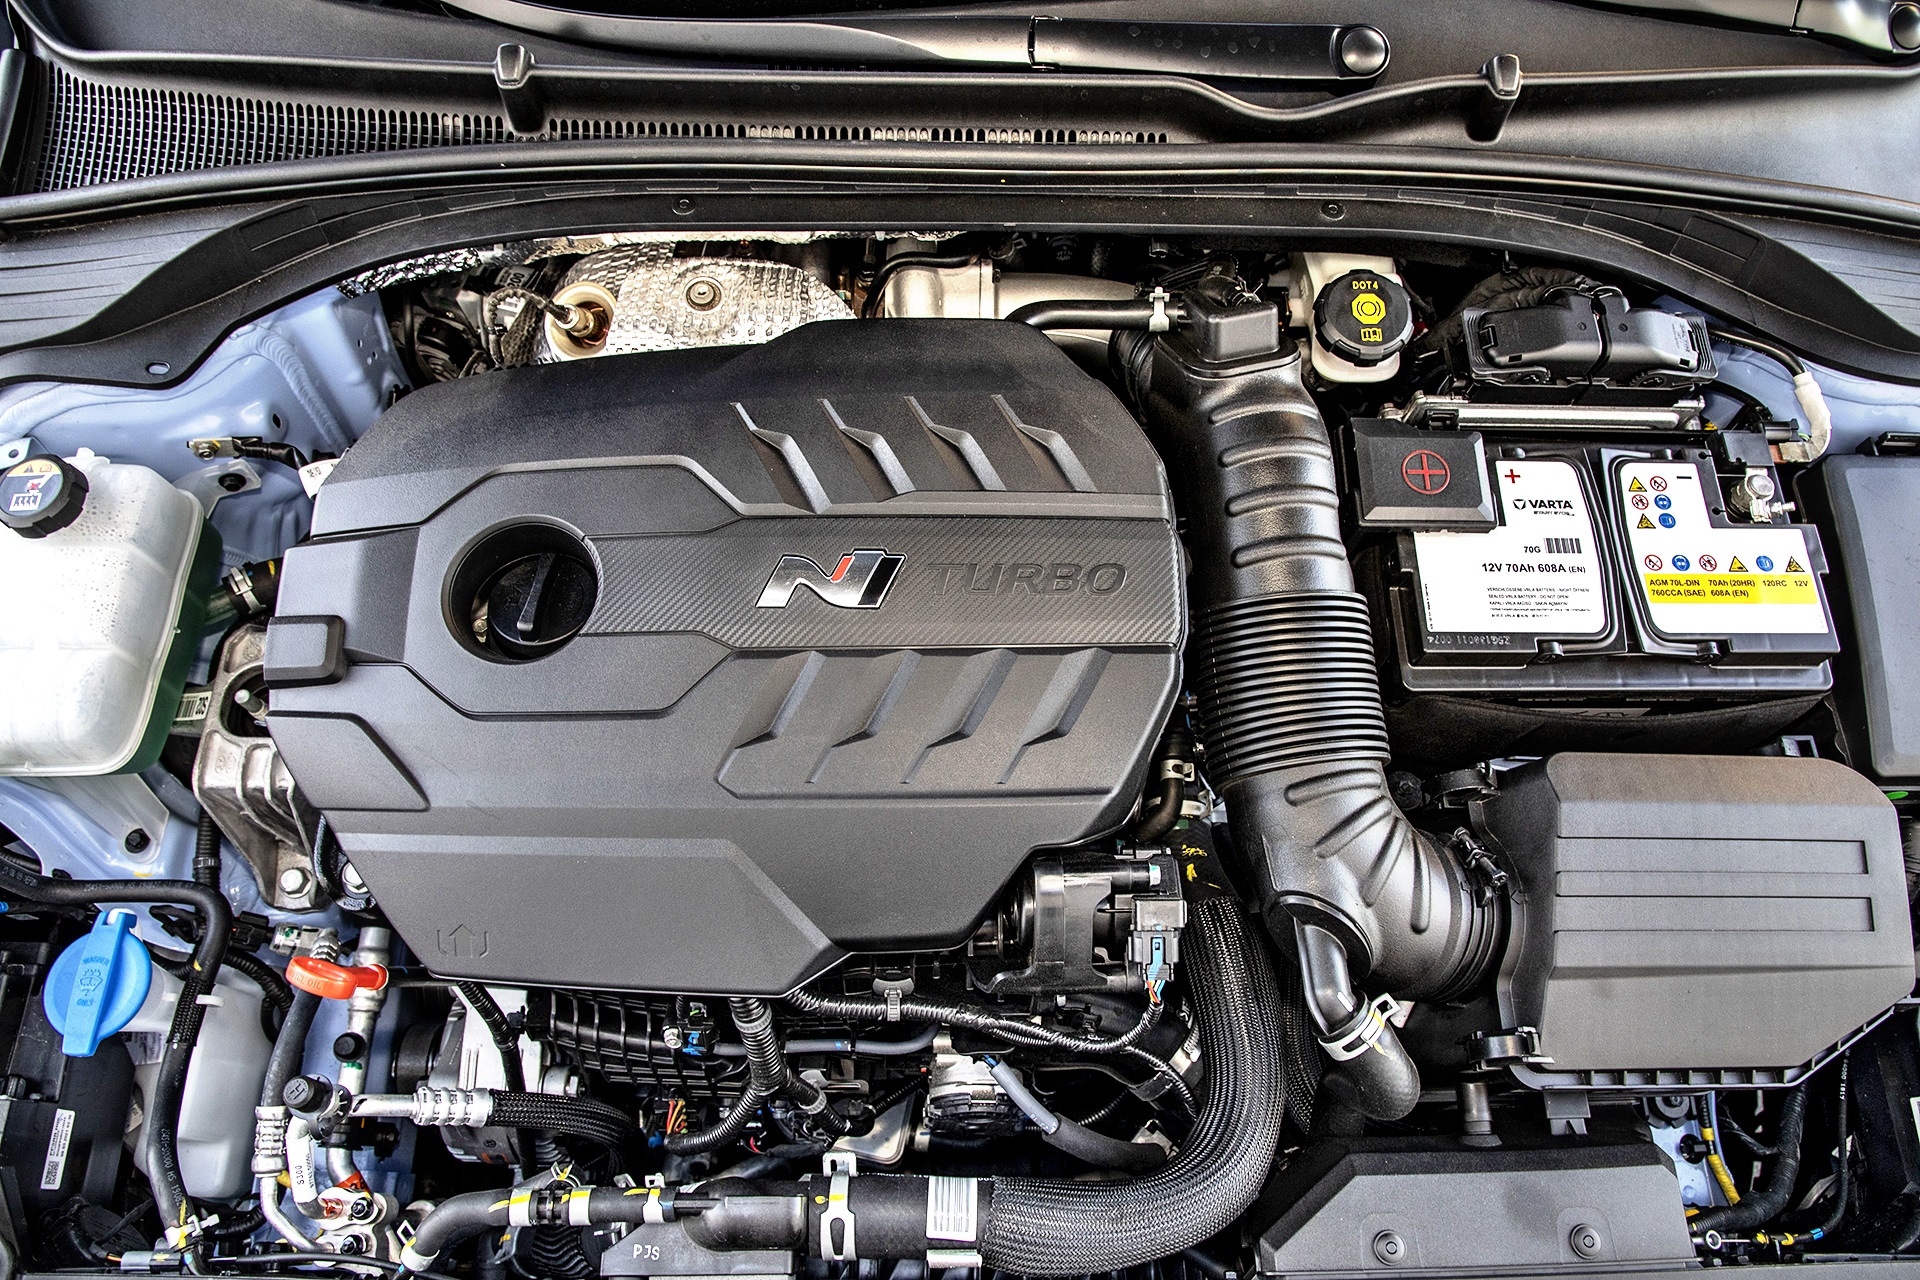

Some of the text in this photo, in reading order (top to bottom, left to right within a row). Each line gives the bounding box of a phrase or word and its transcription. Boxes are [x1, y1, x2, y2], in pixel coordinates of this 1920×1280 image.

[1528, 499, 1573, 509] VARTA
[1523, 545, 1541, 554] 70G
[1482, 563, 1586, 574] 12V 70Ah 608A (EN)
[927, 562, 1129, 597] TURBO
[1649, 579, 1668, 587] AGM
[1670, 579, 1700, 587] 70L-DIN
[1707, 579, 1729, 587] 70Ah
[1729, 579, 1756, 588] (20HR)
[1651, 589, 1749, 598] 760CCA (SAE) 608A (EN)
[82, 955, 110, 966] WASHER
[294, 1164, 305, 1185] S300
[633, 1243, 660, 1261] PJS
